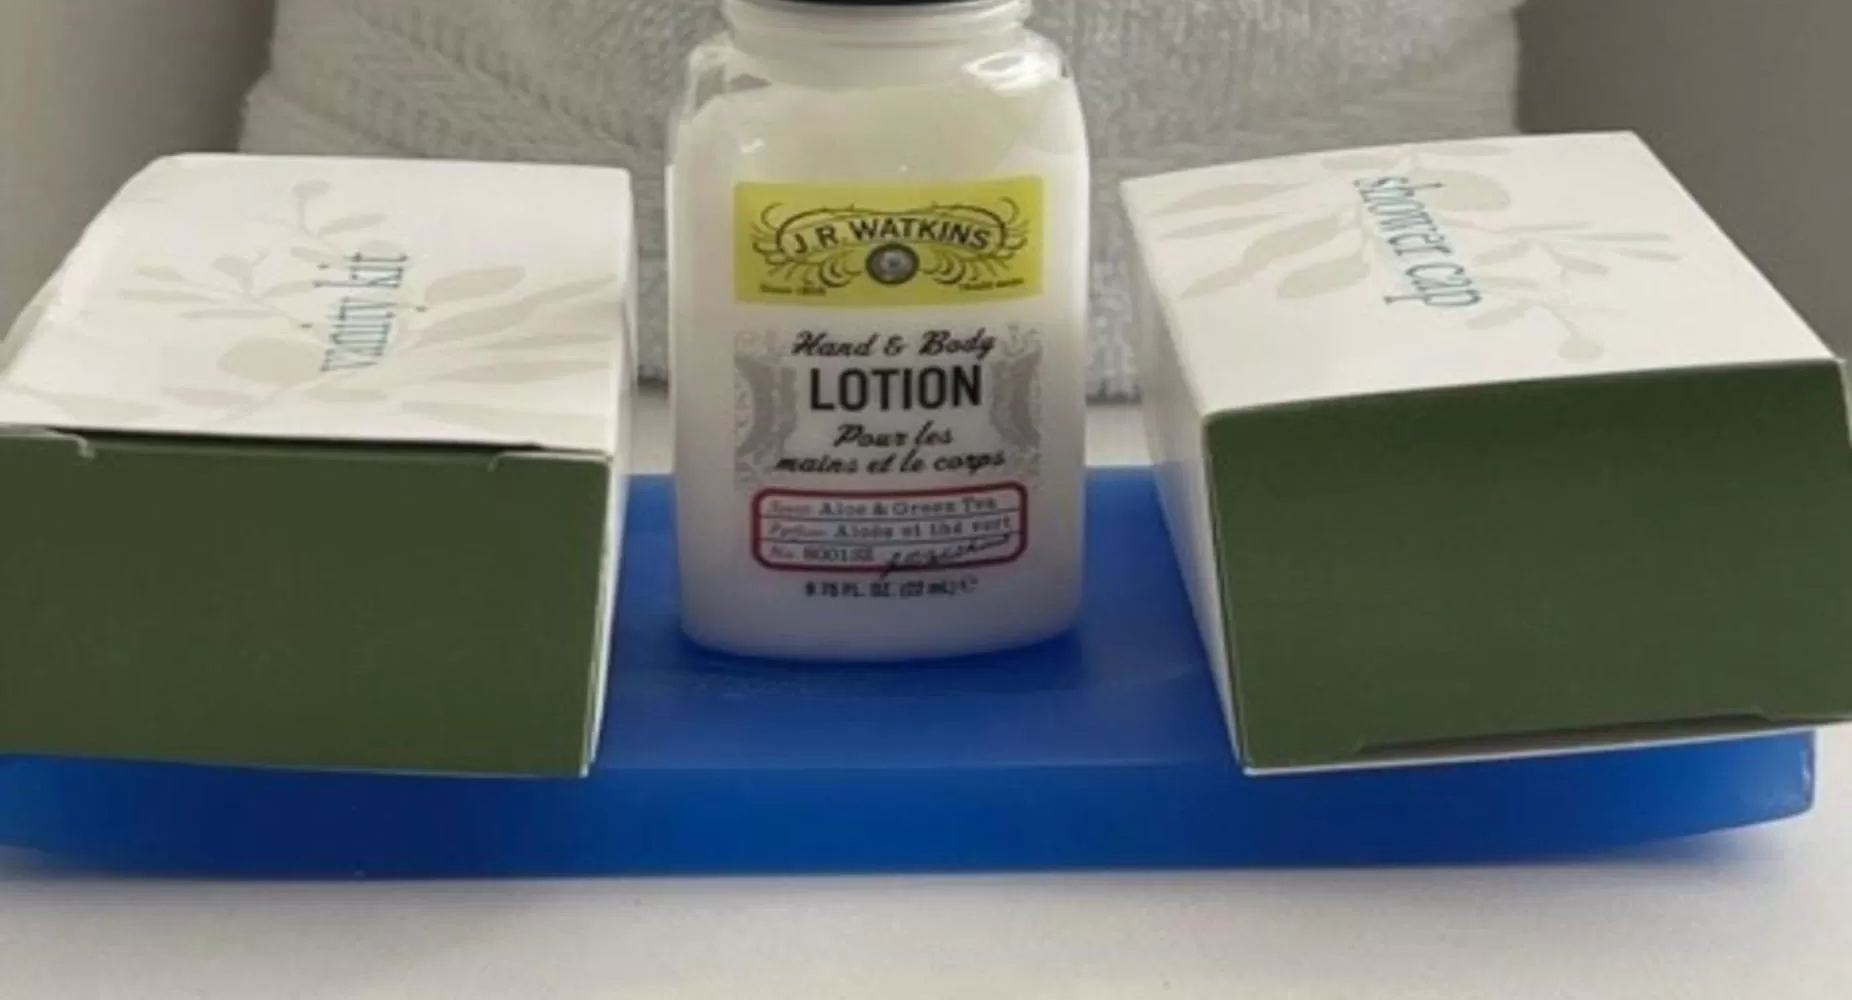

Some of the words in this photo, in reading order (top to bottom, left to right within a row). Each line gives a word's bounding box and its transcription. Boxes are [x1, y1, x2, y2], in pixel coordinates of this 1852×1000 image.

[848, 216, 992, 251] WATKINS
[1353, 177, 1453, 256] shower
[312, 252, 410, 288] kit
[1384, 262, 1482, 307] cap
[299, 296, 428, 373] vanity
[791, 330, 881, 357] Hand
[882, 333, 904, 356] &
[918, 327, 997, 360] Body
[809, 363, 983, 412] LOTION
[833, 423, 909, 448] Pour
[914, 420, 955, 445] les
[775, 454, 860, 473] mains
[866, 453, 897, 474] et
[899, 449, 927, 473] le
[932, 451, 1006, 478] corps
[892, 499, 957, 515] Green
